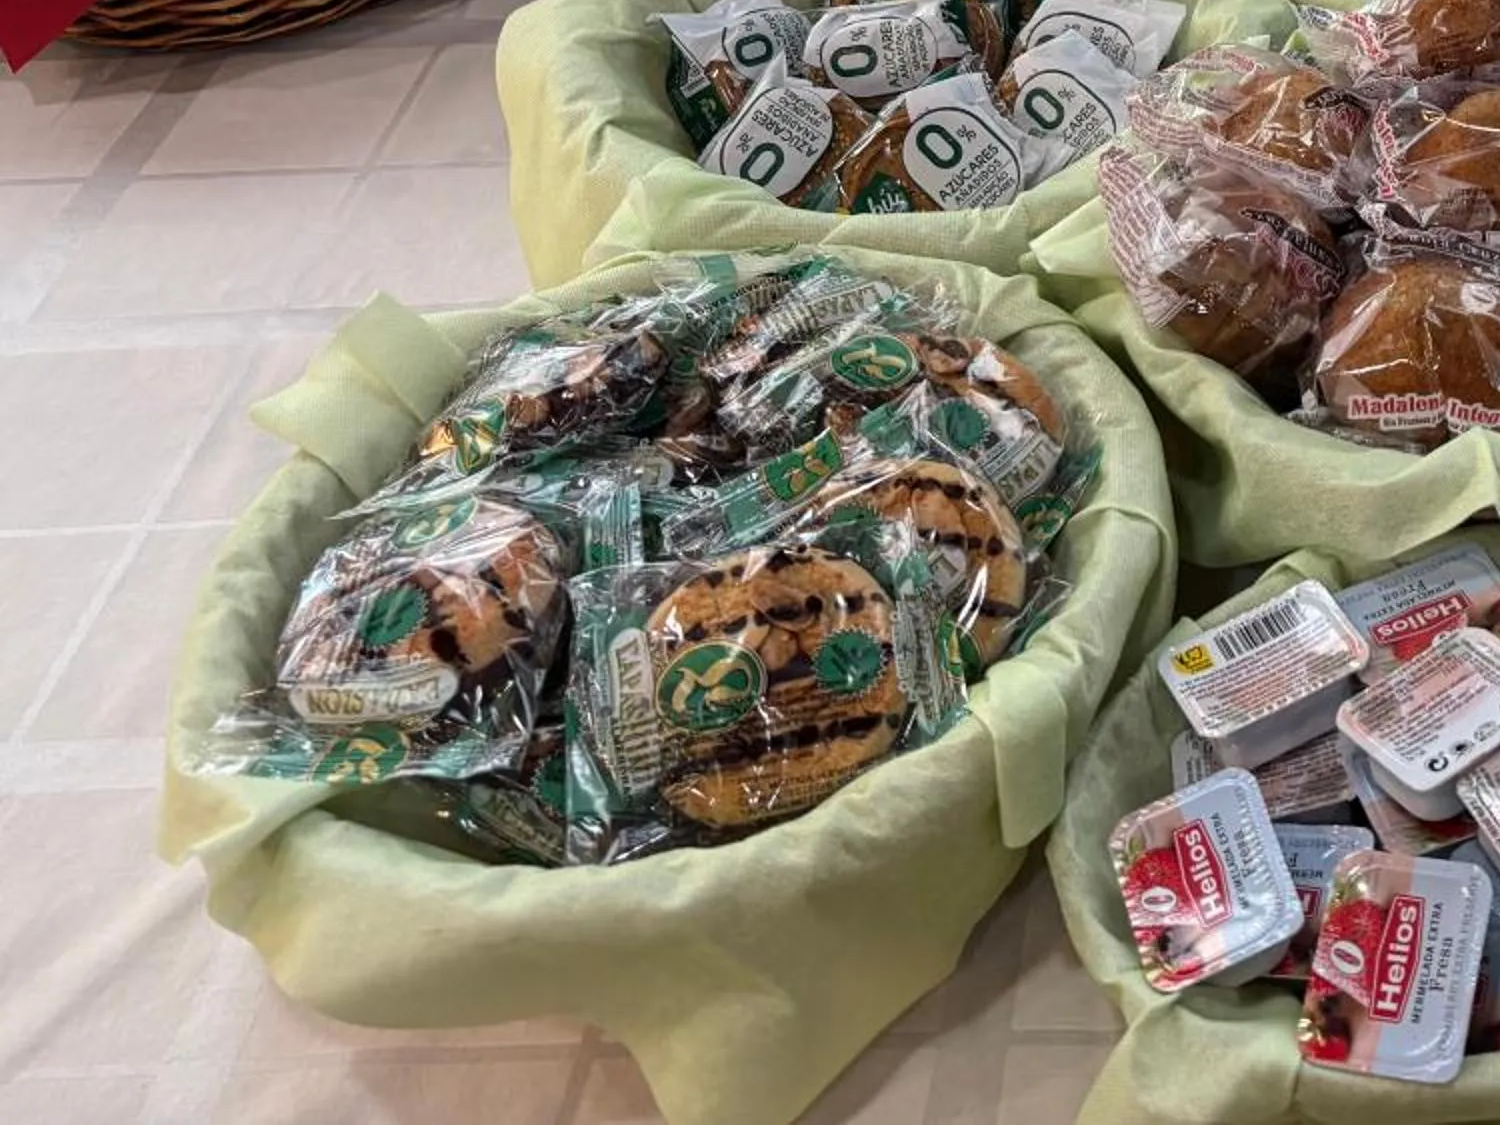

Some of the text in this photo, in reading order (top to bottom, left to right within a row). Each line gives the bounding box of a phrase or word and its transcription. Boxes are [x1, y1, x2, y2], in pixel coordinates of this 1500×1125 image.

[1351, 393, 1442, 416] Madalen
[1377, 599, 1463, 637] Helios
[1184, 827, 1225, 920] Helios
[1376, 903, 1418, 1012] Helios
[1410, 901, 1444, 1024] MERMELADA EXTRA
[1429, 937, 1455, 993] Fresa
